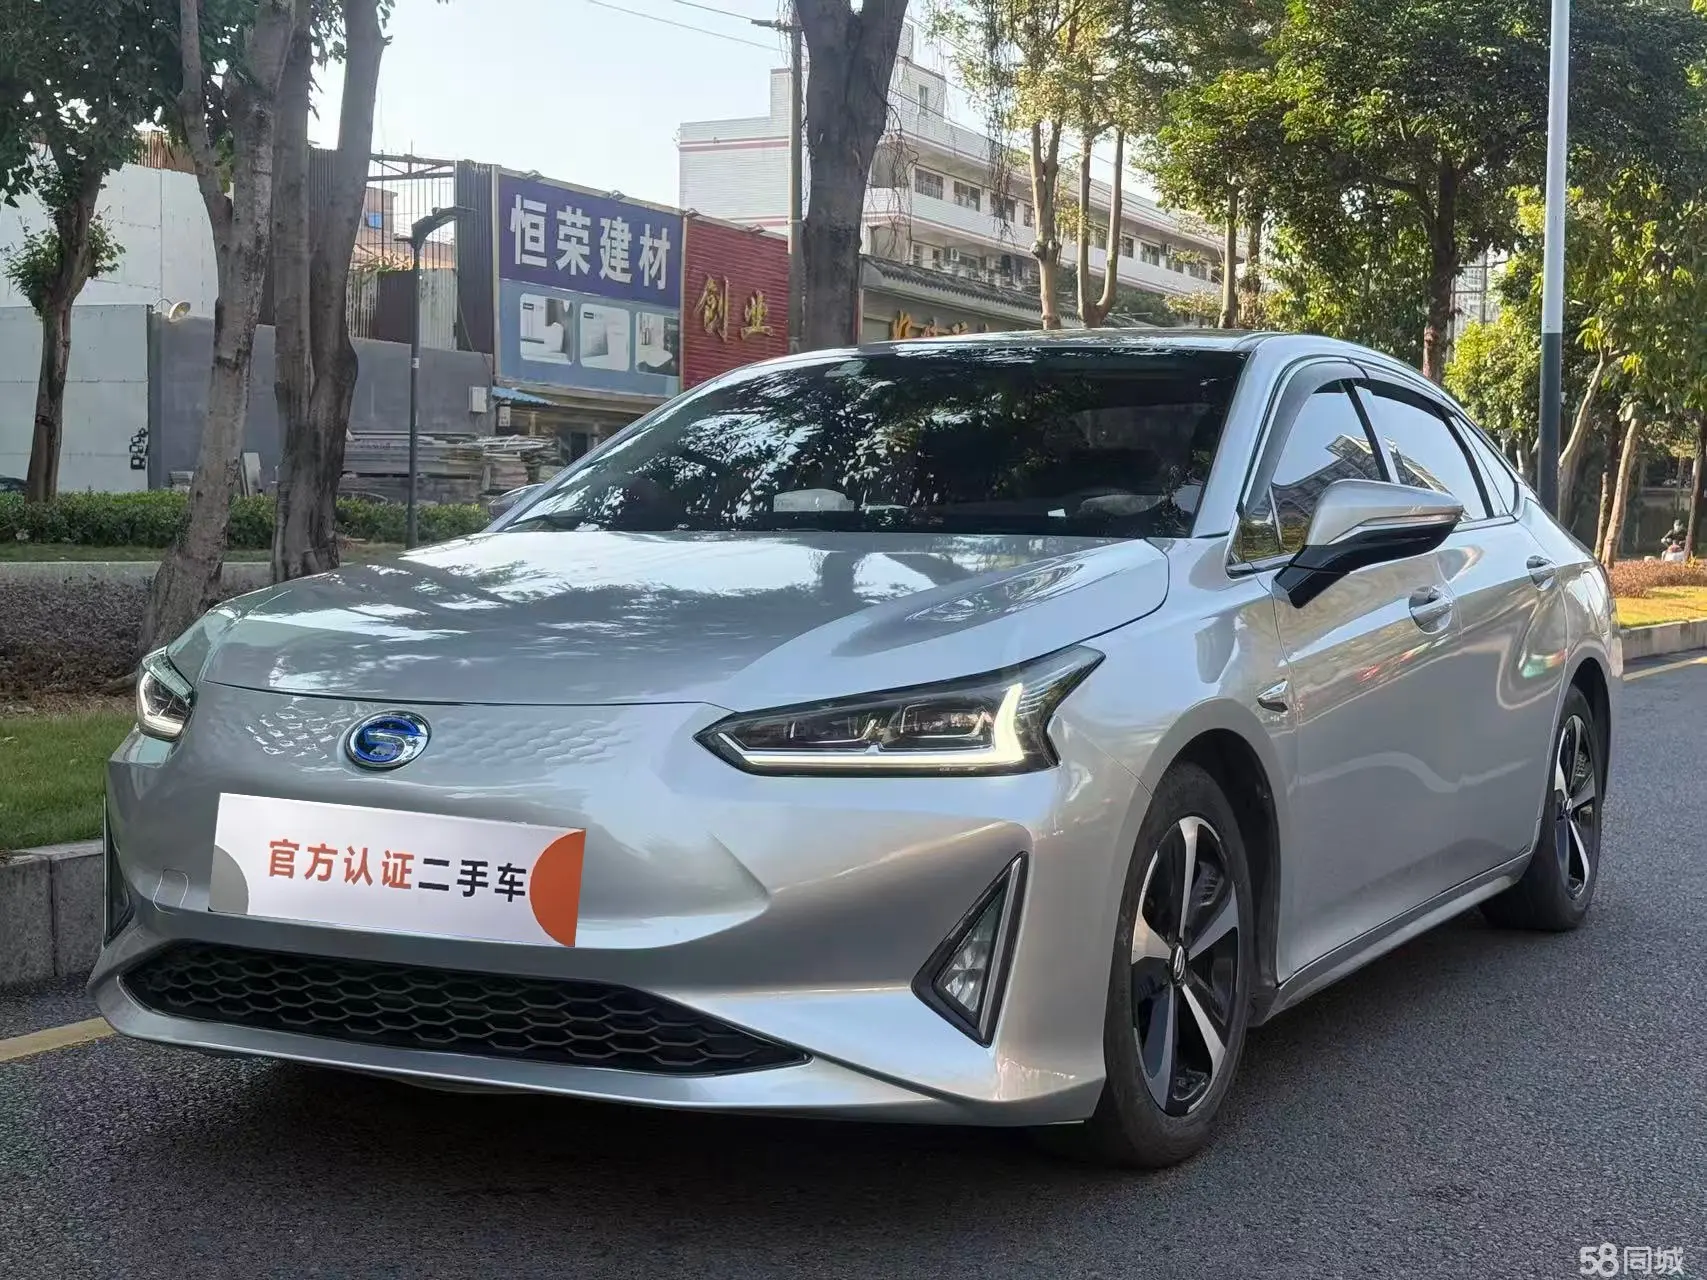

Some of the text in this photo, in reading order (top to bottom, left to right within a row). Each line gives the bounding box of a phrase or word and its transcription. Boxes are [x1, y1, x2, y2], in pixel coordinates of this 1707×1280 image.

[510, 194, 671, 290] 恒荣建材
[694, 272, 775, 342] 创业
[268, 838, 527, 903] 官方认证二手车
